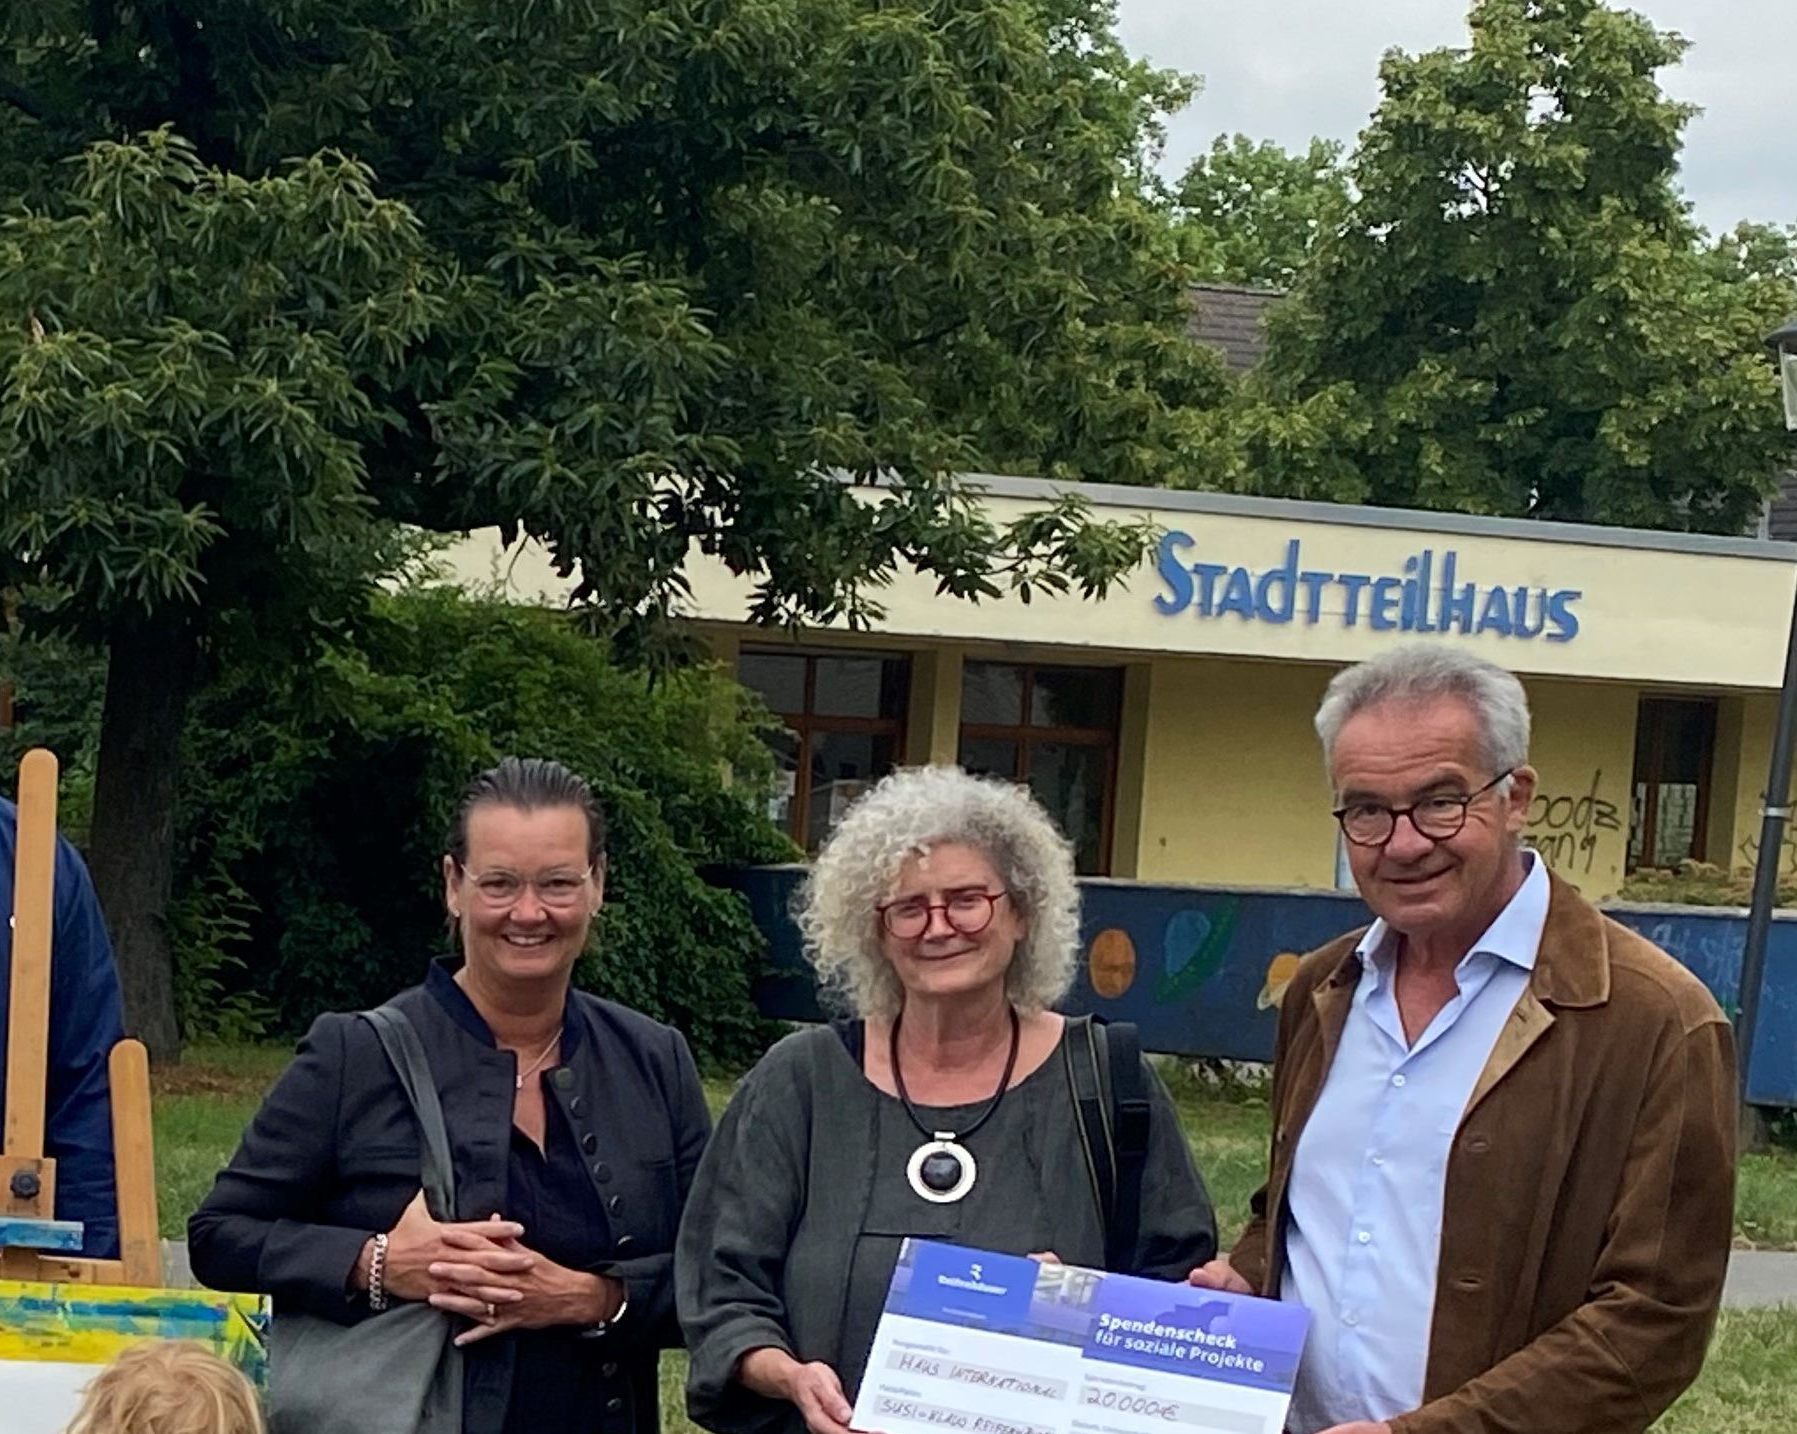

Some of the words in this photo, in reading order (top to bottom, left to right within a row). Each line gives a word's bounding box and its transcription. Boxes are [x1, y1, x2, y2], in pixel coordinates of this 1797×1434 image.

[1099, 1313, 1237, 1350] Spendenscheck
[1095, 1331, 1122, 1347] für
[1124, 1335, 1185, 1359] soziale
[1189, 1345, 1265, 1373] Projekte
